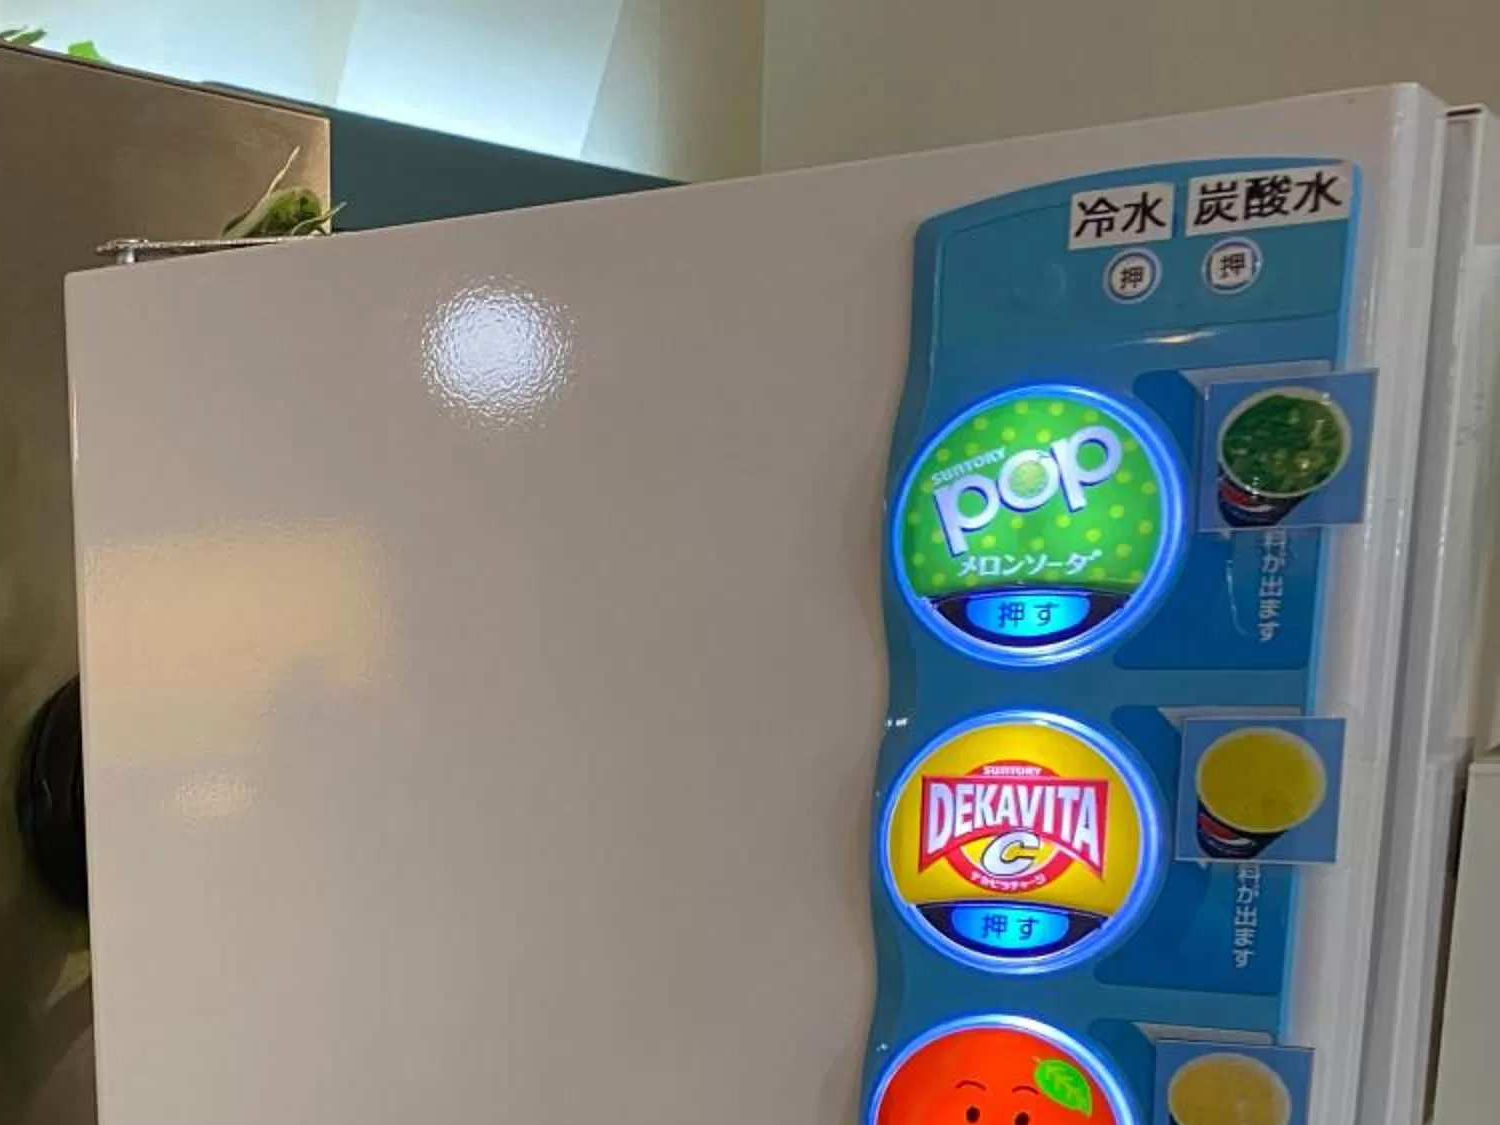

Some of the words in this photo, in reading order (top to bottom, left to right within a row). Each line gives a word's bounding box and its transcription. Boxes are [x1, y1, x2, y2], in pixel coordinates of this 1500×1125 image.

[1073, 191, 1167, 239] 冷水
[1193, 171, 1342, 227] 炭酸水
[1119, 266, 1144, 290] 押
[1220, 252, 1247, 279] 押
[931, 446, 1006, 485] SUNTORY
[934, 424, 1122, 558] pop
[957, 549, 1103, 577] メロンソーダ
[998, 601, 1060, 628] 押す
[983, 765, 1042, 777] SUNTORY
[927, 781, 1100, 866] DEKAVITA
[981, 829, 1040, 876] C
[980, 913, 1040, 940] 押す
